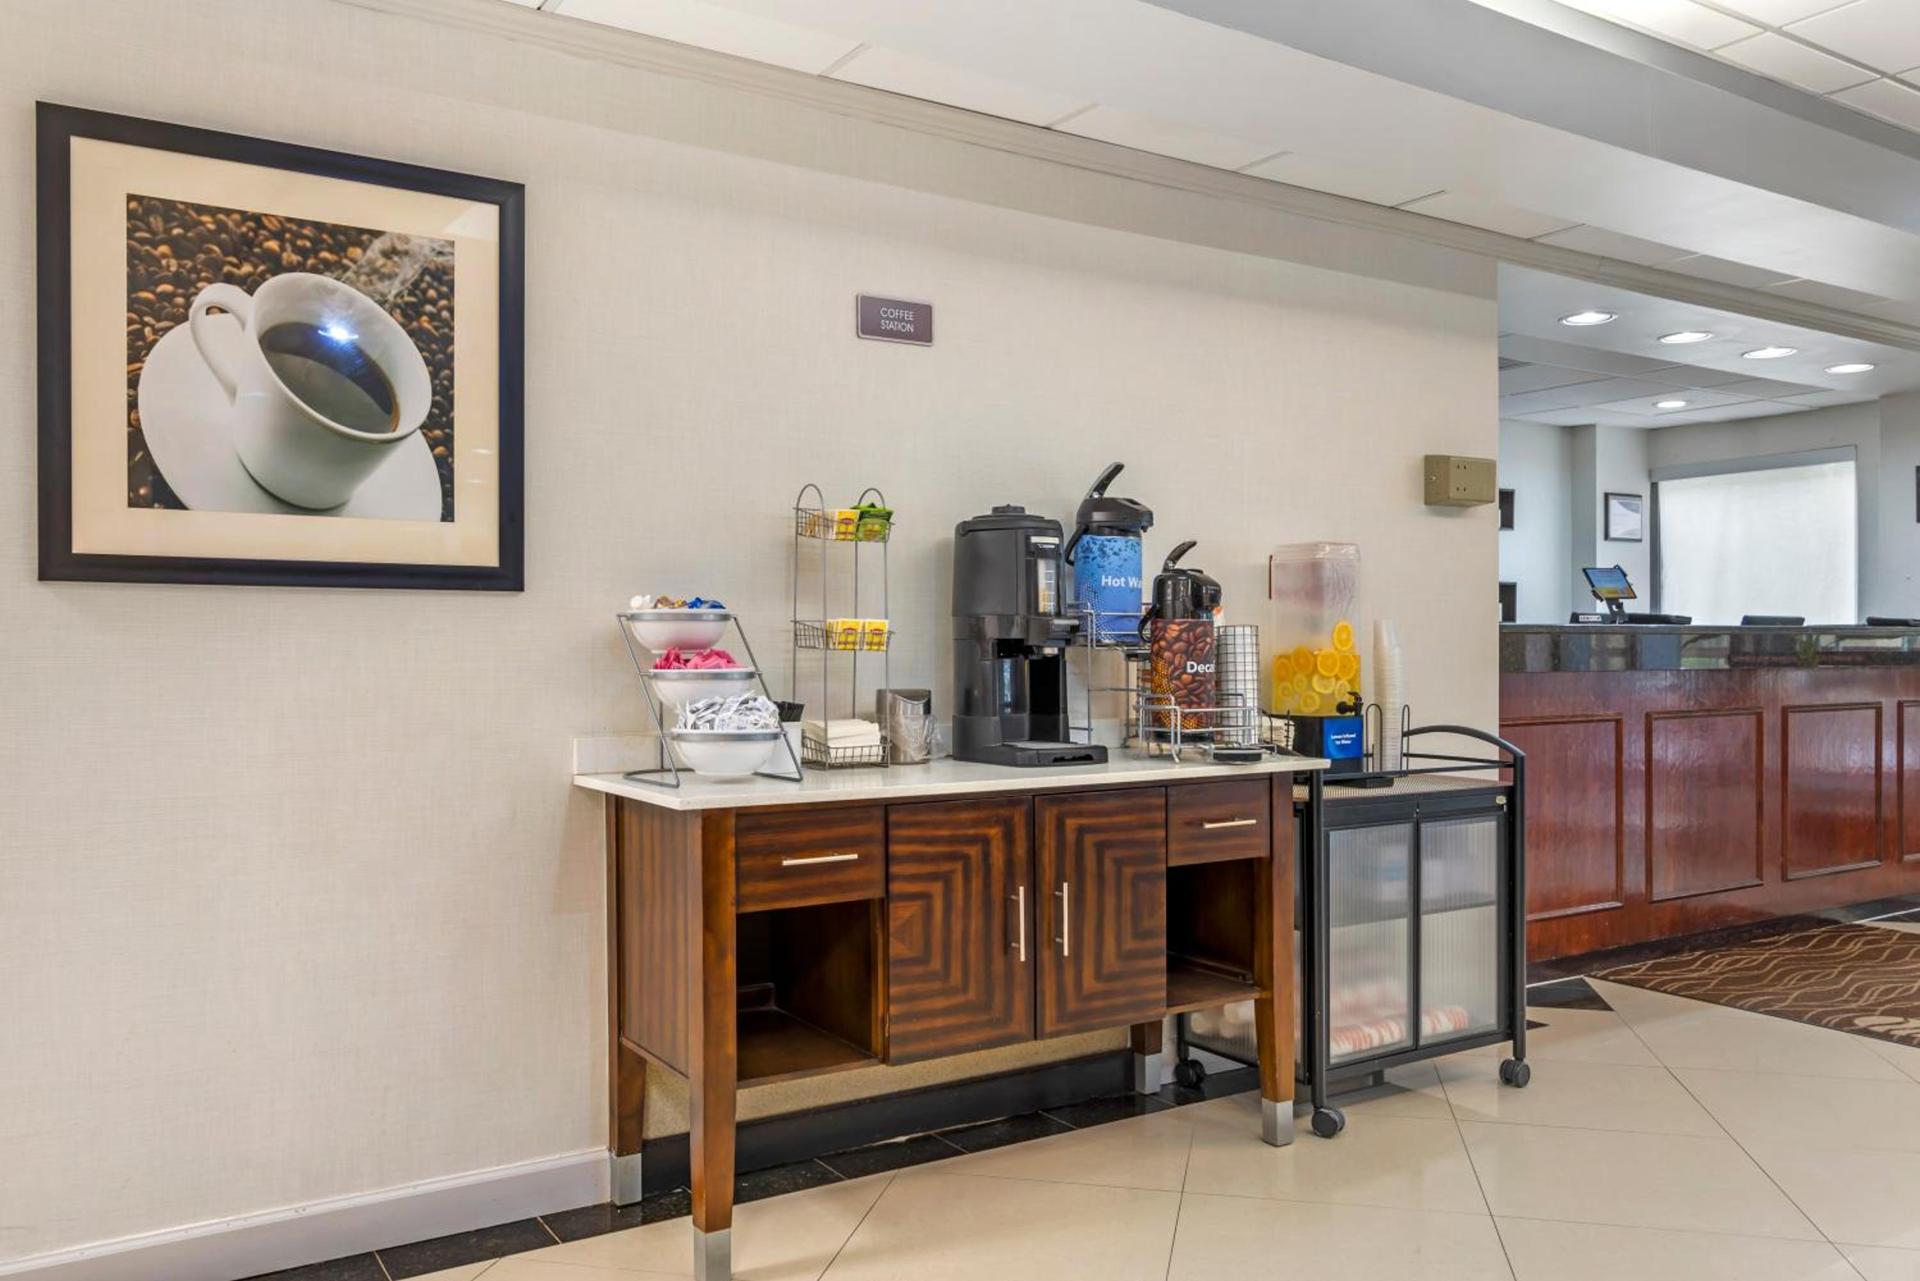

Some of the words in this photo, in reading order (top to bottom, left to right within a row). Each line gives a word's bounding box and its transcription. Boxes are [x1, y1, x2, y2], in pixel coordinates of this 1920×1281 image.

[880, 307, 914, 321] COFFEE
[880, 319, 914, 333] STATION
[1101, 575, 1126, 588] Hot
